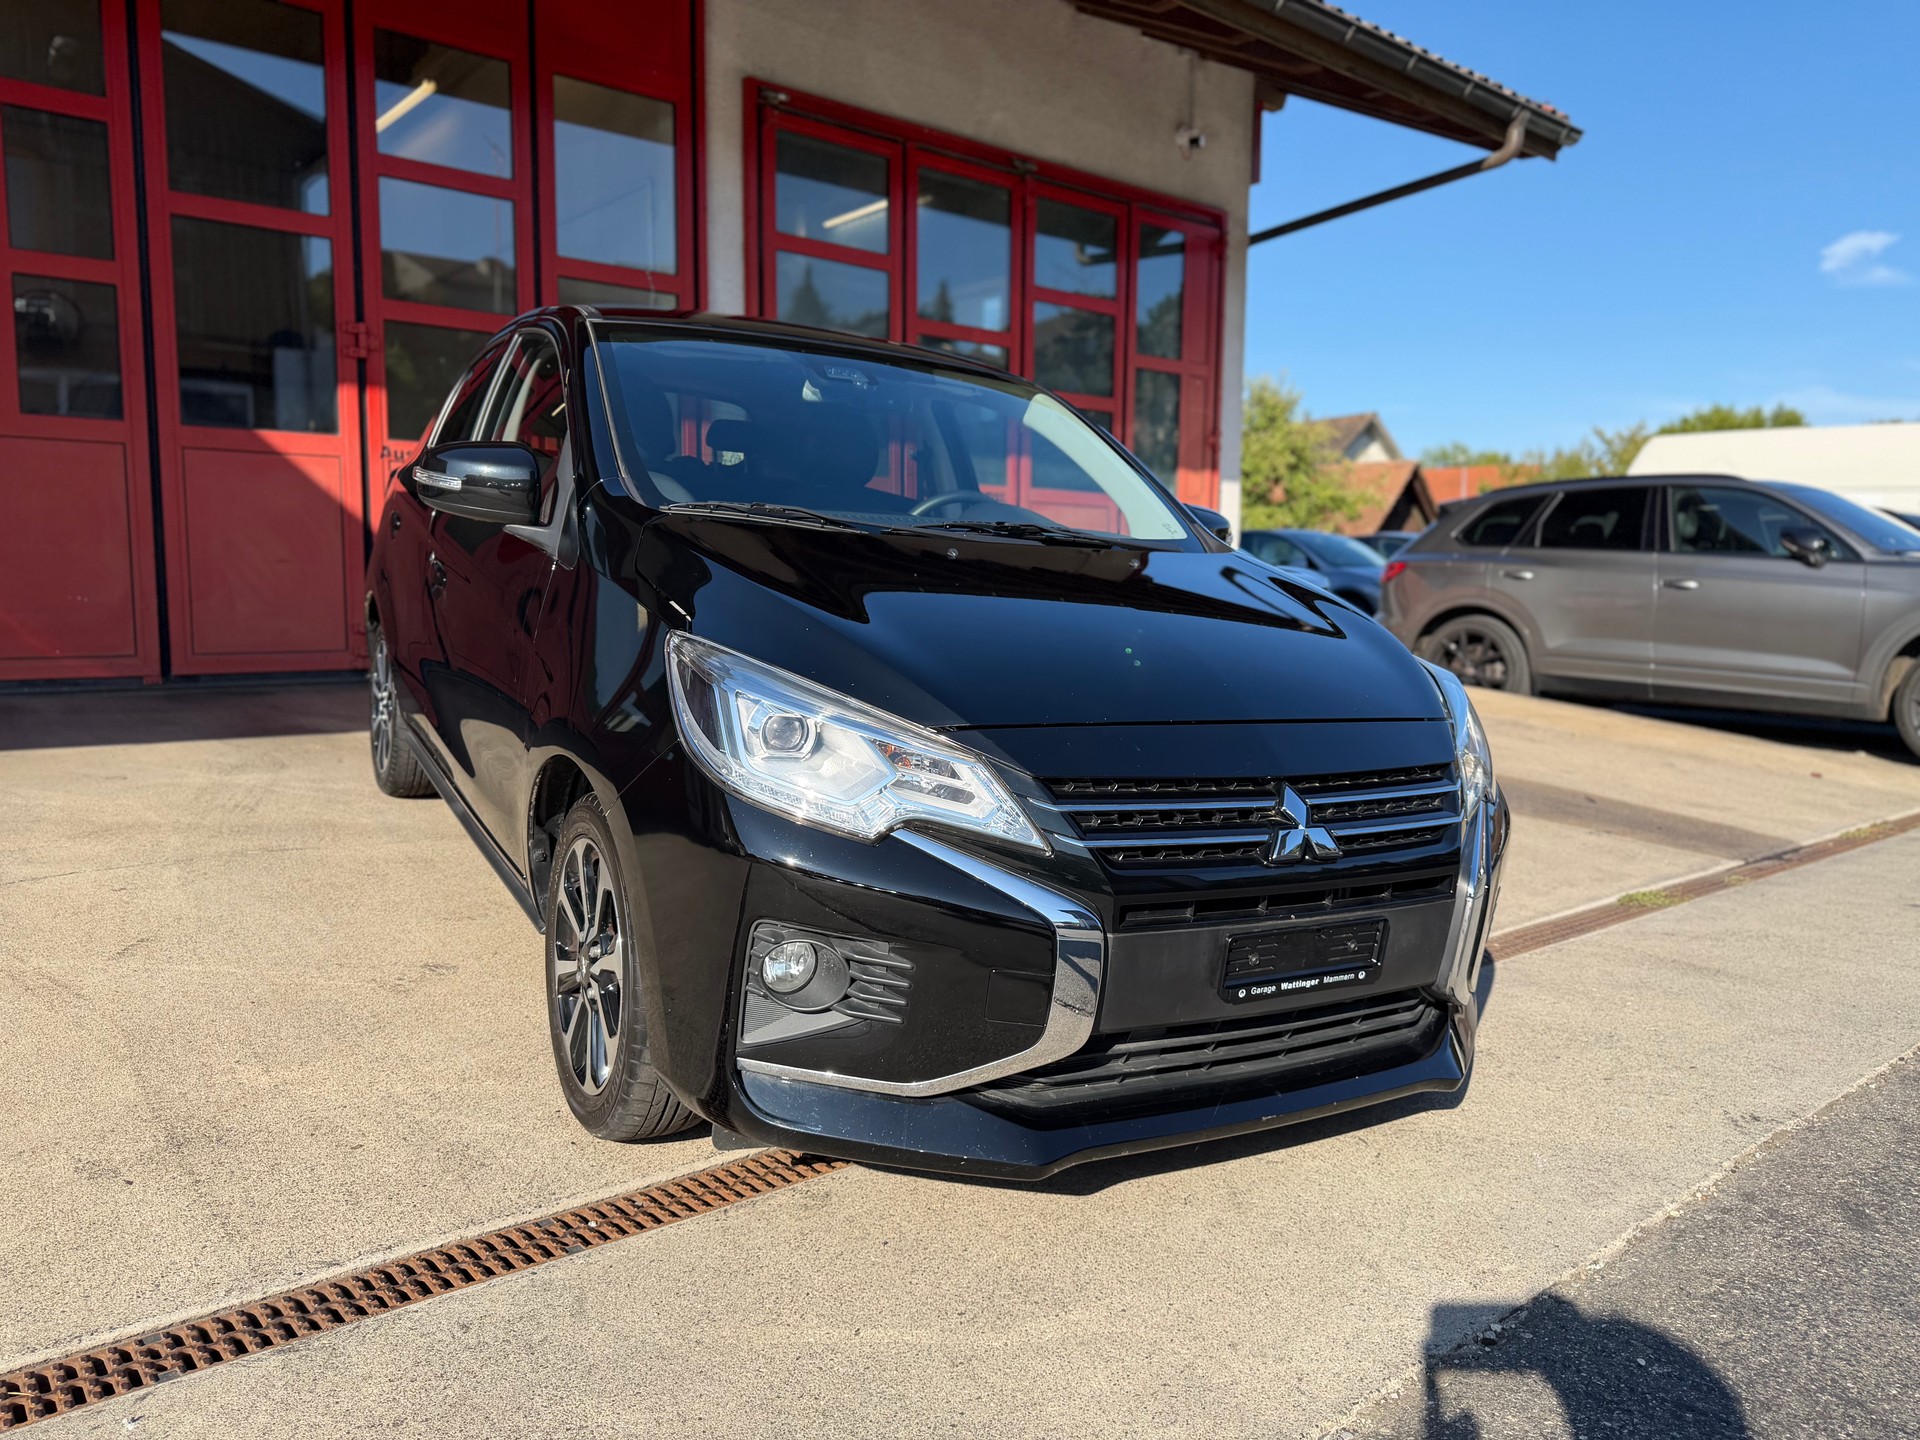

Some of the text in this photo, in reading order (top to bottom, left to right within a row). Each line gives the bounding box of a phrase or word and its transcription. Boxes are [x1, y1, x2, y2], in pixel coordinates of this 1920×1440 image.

[1250, 973, 1355, 995] Garage Wattinger Mammern
